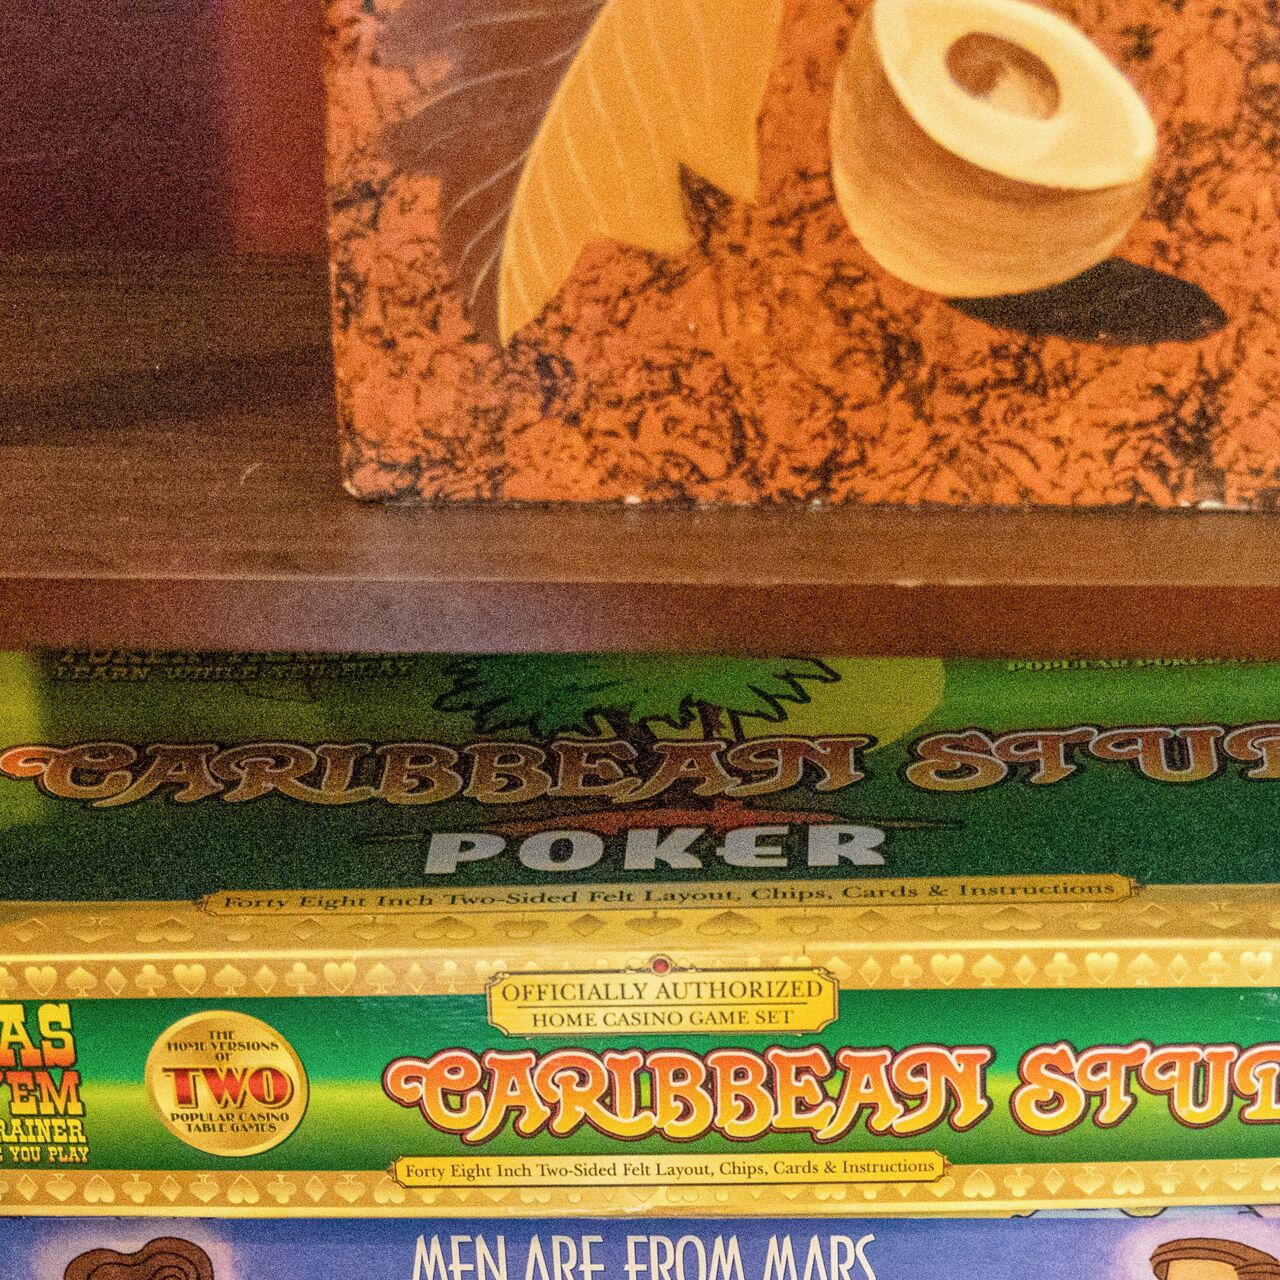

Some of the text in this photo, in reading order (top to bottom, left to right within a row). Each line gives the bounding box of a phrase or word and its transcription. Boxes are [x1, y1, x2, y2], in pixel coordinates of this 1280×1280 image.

[424, 824, 886, 874] POKER
[224, 880, 1116, 911] Forty Eight Inch Two-Sided Felt Layout, Chips, Cards & Instructions
[502, 979, 823, 1003] OFFICIALLY AUTHORIZED
[532, 1009, 795, 1028] HOME CASINO GAME SET
[209, 1030, 235, 1041] THE
[167, 1041, 279, 1052] HOME VERSIONS
[162, 1066, 294, 1109] TWO
[382, 1044, 995, 1144] CARIBBEAN
[171, 1112, 290, 1122] POPULAR CASINO
[186, 1123, 277, 1133] TABLE GAMES
[9, 1146, 41, 1162] YOU
[48, 1146, 89, 1163] PLAY
[406, 1158, 935, 1181] Forty Eight Inch Two-Sided Felt Layout, Chips, Cards & Instructions
